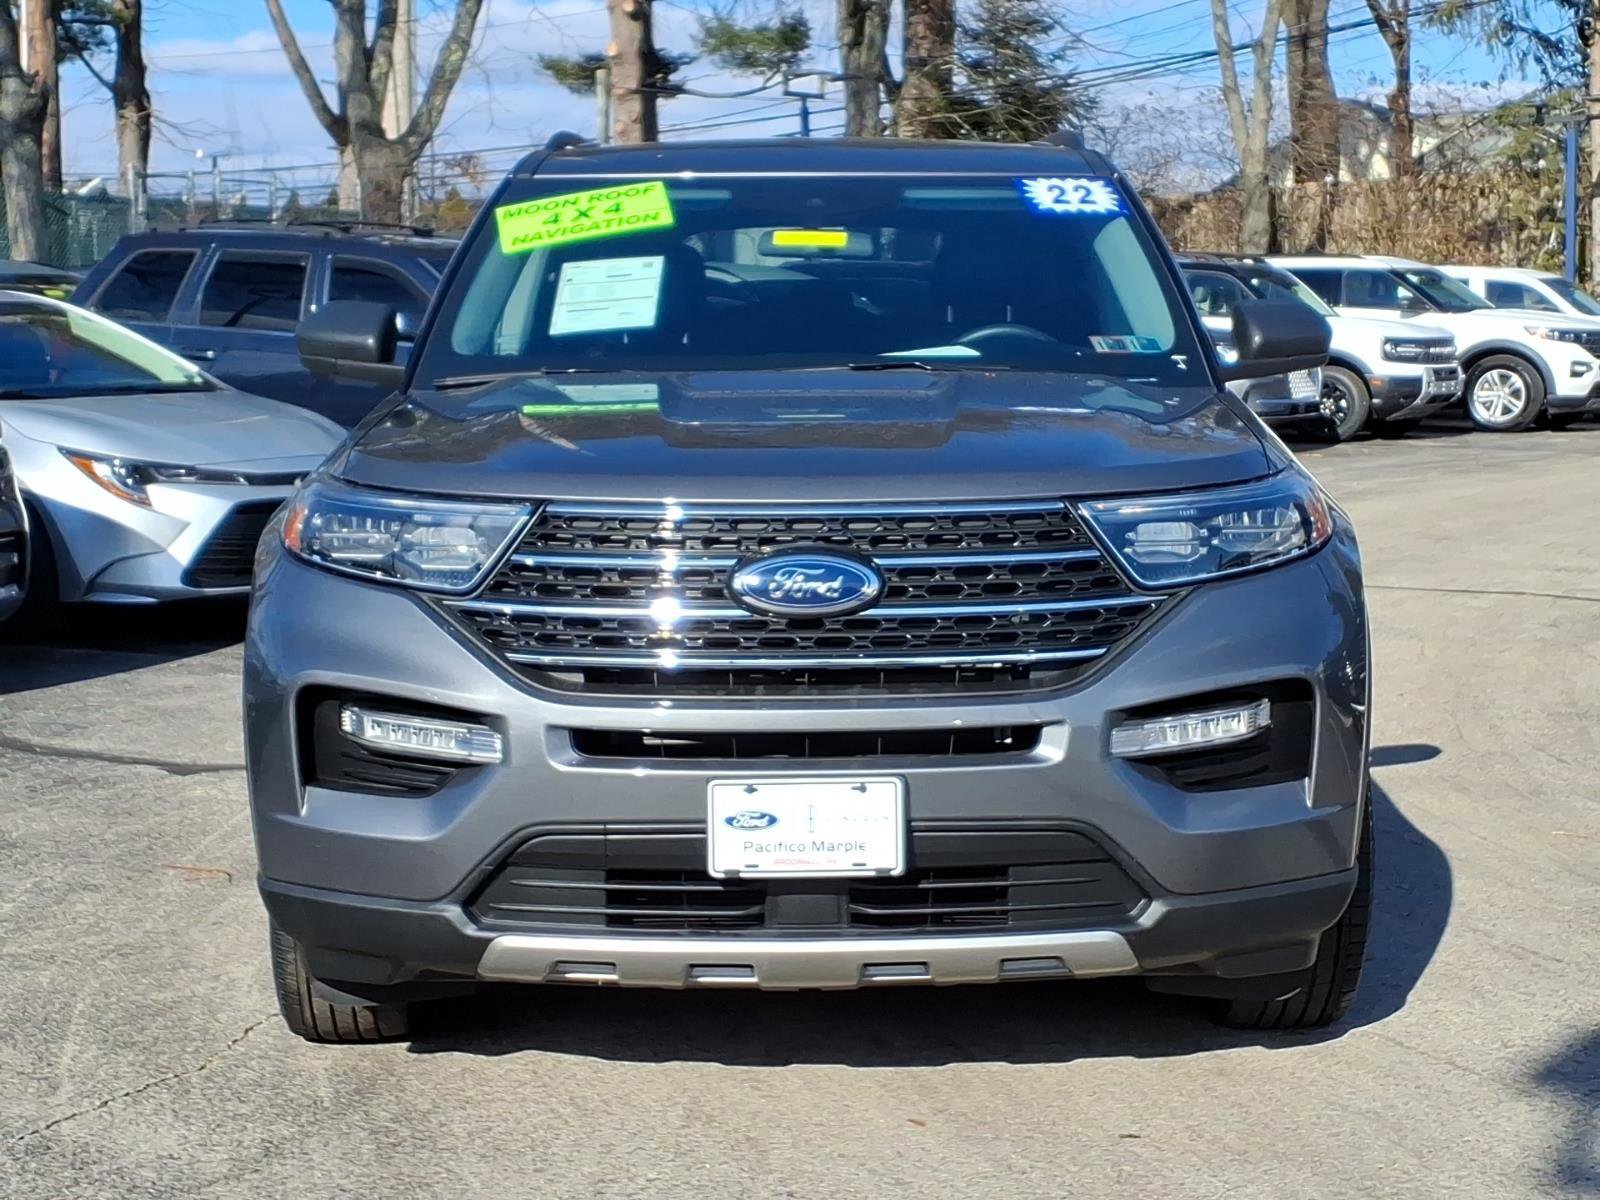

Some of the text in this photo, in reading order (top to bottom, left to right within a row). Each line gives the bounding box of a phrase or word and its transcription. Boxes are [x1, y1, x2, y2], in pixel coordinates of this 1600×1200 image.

[502, 184, 657, 220] MOON ROOF
[1046, 184, 1099, 205] 22
[541, 212, 563, 225] 4
[603, 202, 624, 214] 4
[511, 211, 661, 246] NAVIGATION
[768, 567, 844, 598] Ford
[732, 810, 770, 828] Ford
[743, 840, 806, 853] Pacifico
